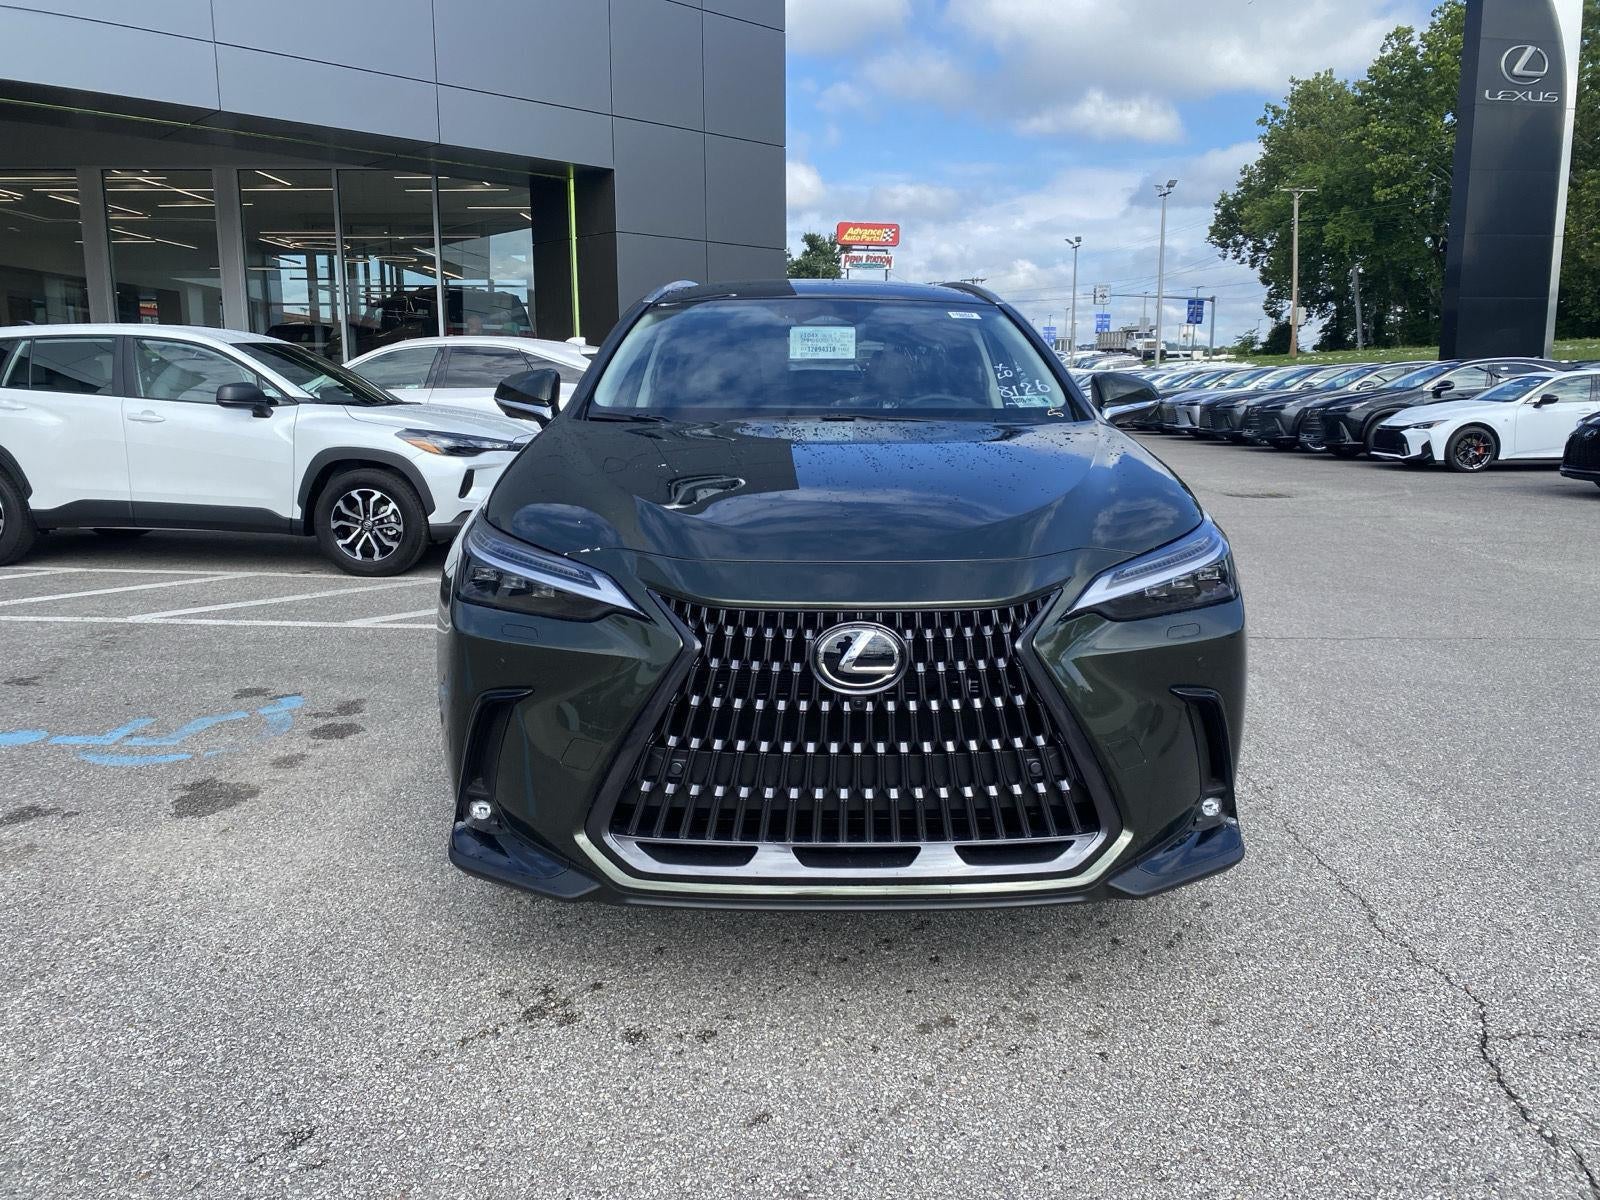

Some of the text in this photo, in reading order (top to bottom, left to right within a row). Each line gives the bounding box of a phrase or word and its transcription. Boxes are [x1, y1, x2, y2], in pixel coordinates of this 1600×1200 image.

[1485, 89, 1559, 103] LEXUS
[846, 227, 882, 236] Advance
[860, 234, 881, 242] Parts
[865, 254, 893, 269] STATION
[997, 379, 1051, 398] 8126
